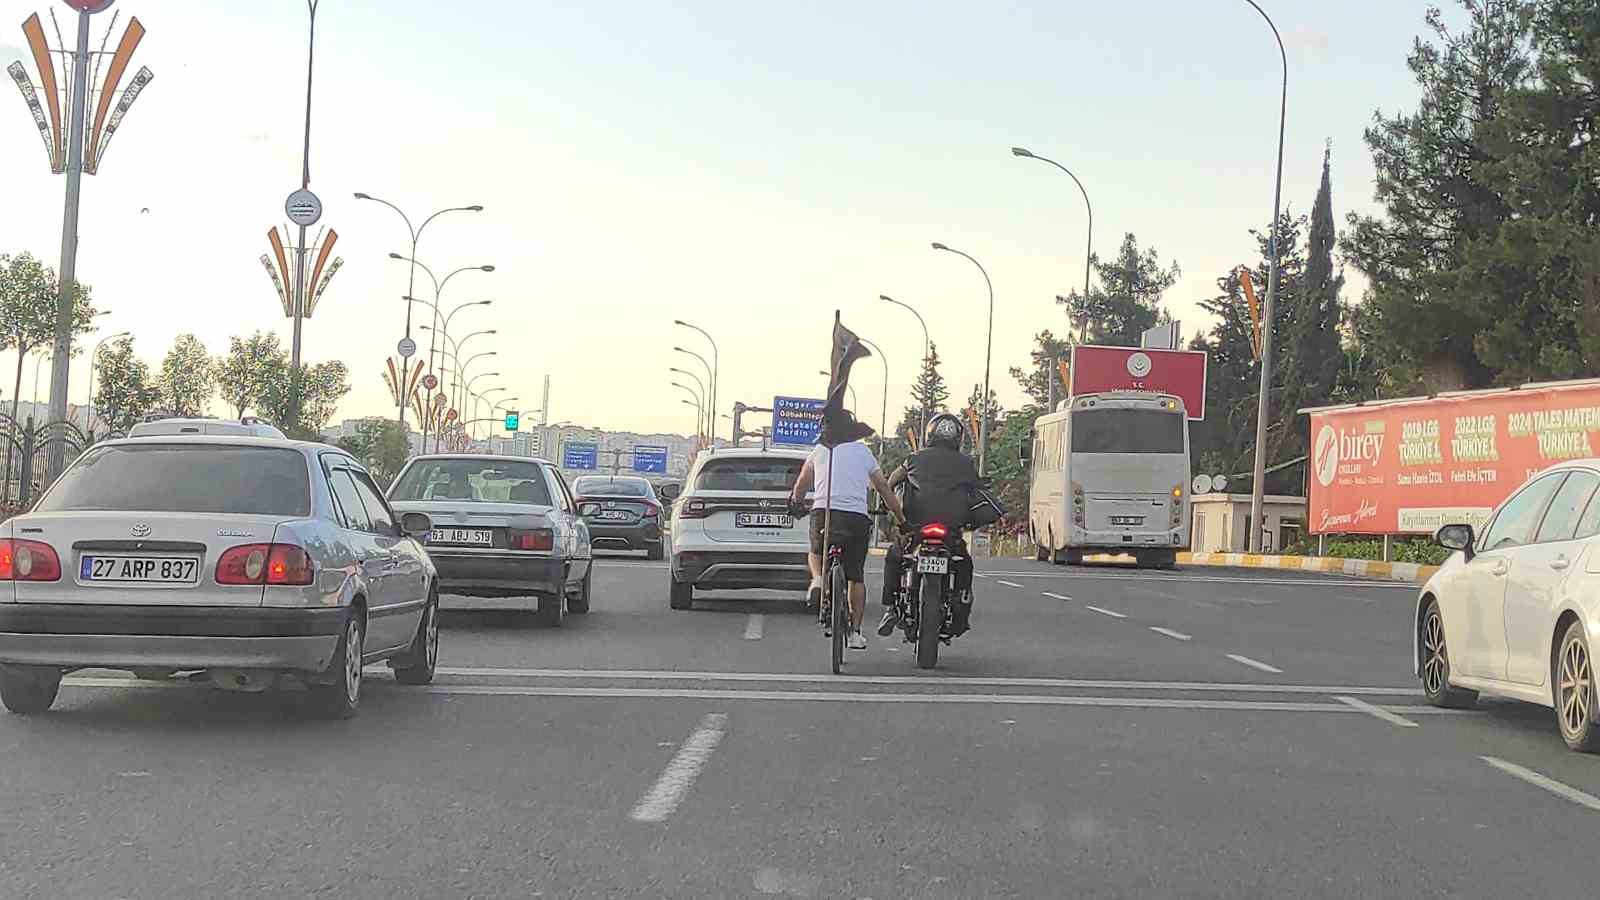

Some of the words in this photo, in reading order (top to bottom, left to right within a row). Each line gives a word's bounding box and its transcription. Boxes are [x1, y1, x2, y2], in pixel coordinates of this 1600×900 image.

[1402, 420, 1423, 439] 2019
[1455, 415, 1477, 435] 2022
[1508, 412, 1532, 434] 2024
[1340, 427, 1385, 467] birey
[1399, 437, 1433, 461] TÜRKİYE
[1451, 433, 1489, 459] TÜRKİYE
[1537, 428, 1580, 456] TÜRKİYE
[93, 559, 116, 578] 27
[120, 560, 156, 579] ARP
[160, 561, 196, 580] 837
